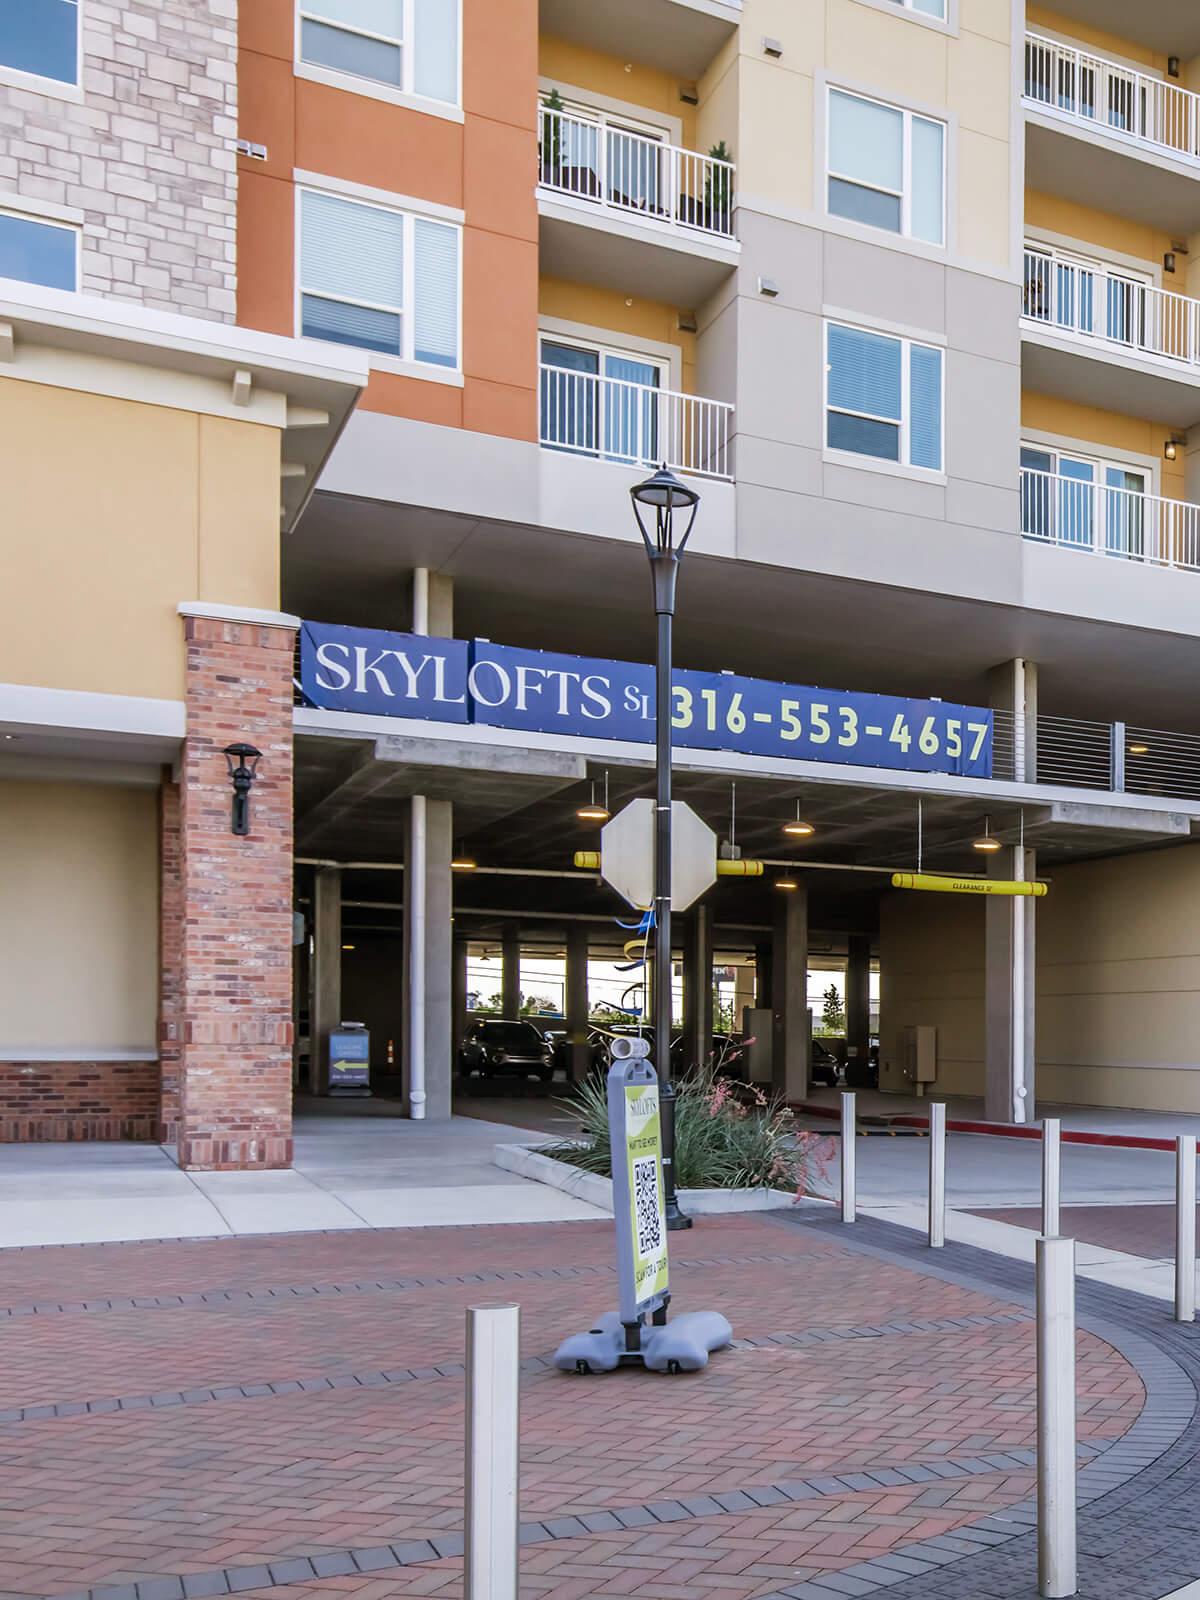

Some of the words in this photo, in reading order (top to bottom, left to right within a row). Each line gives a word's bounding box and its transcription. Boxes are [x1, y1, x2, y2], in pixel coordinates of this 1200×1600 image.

[315, 642, 612, 720] SKYLOFTS
[671, 686, 989, 761] 316-553-4657
[952, 882, 985, 891] CLEARANCE
